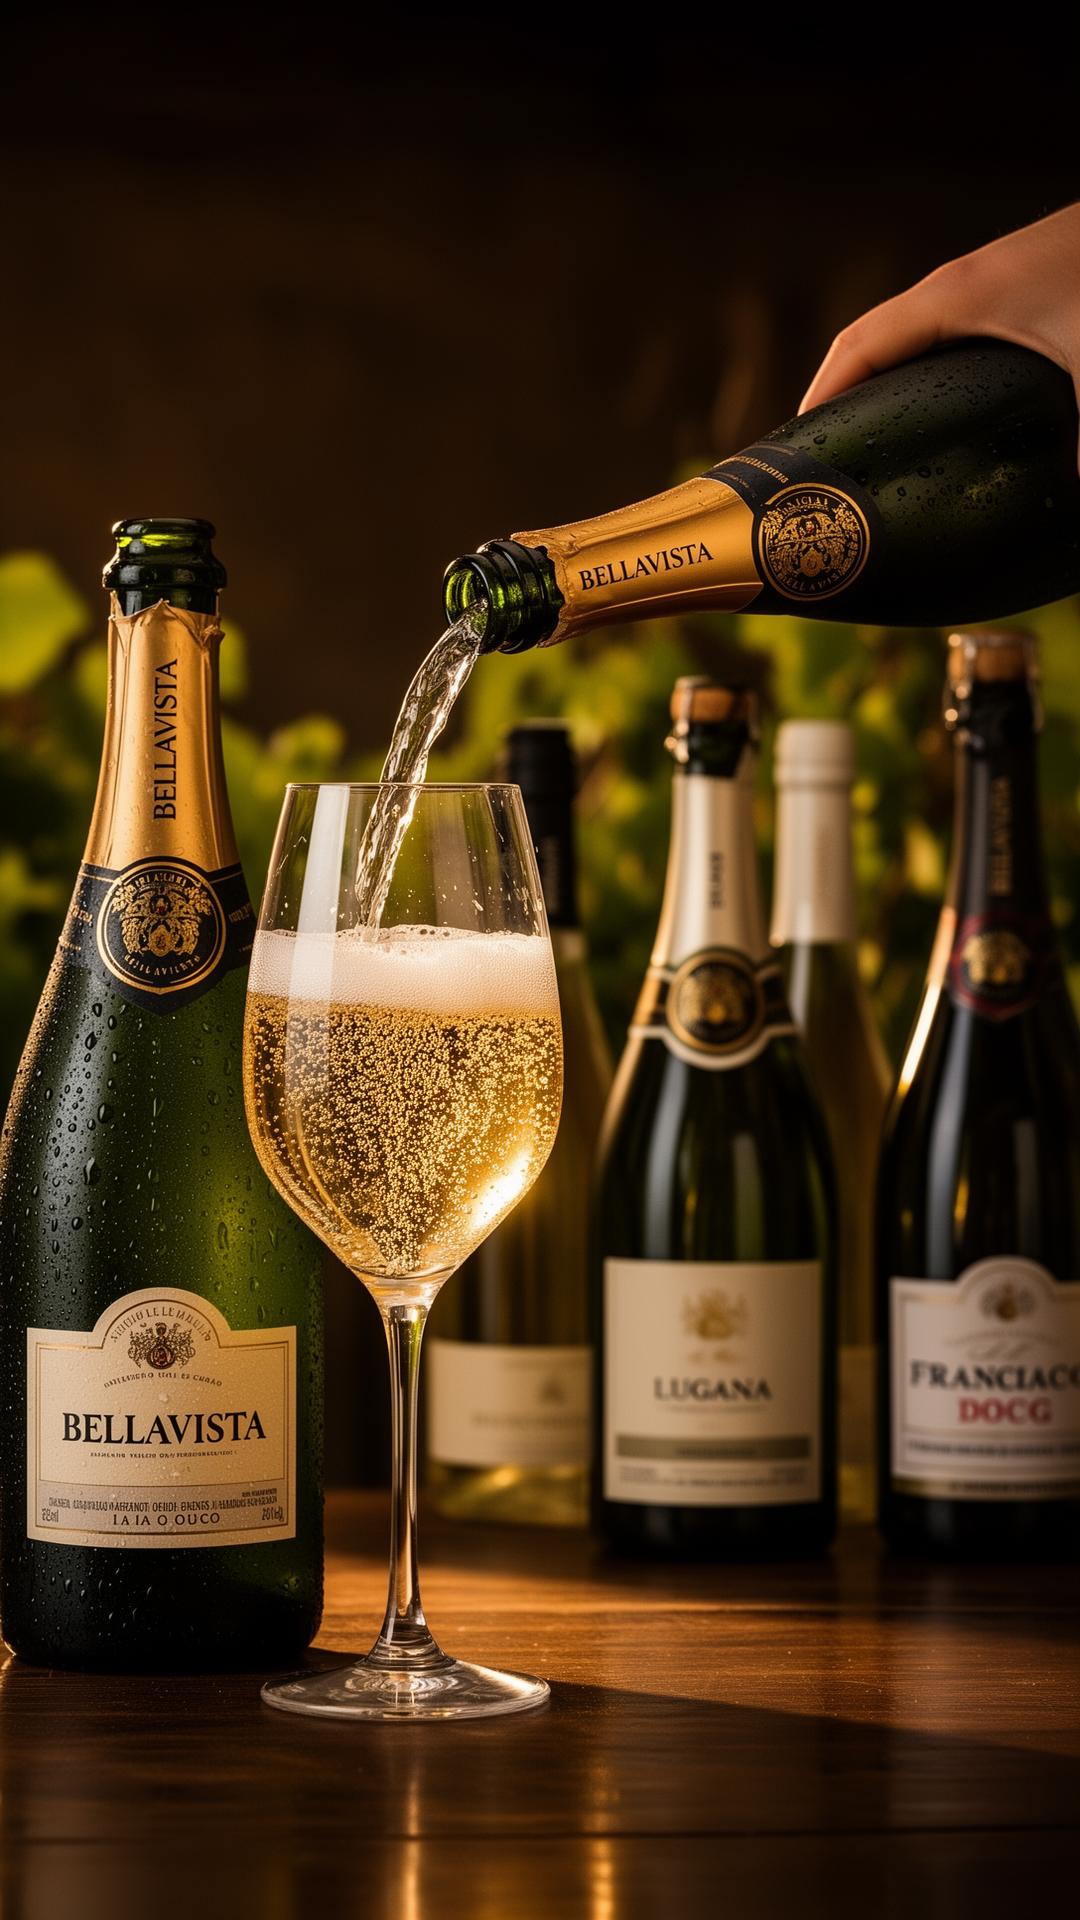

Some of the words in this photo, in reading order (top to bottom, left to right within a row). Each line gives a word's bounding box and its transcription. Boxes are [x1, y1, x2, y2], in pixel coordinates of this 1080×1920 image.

[578, 542, 714, 590] BELLAVISTA
[153, 658, 178, 820] BELLAVISTA
[653, 1377, 773, 1401] LUGANA
[62, 1410, 267, 1445] BELLAVISTA
[958, 1397, 1052, 1425] DOCG
